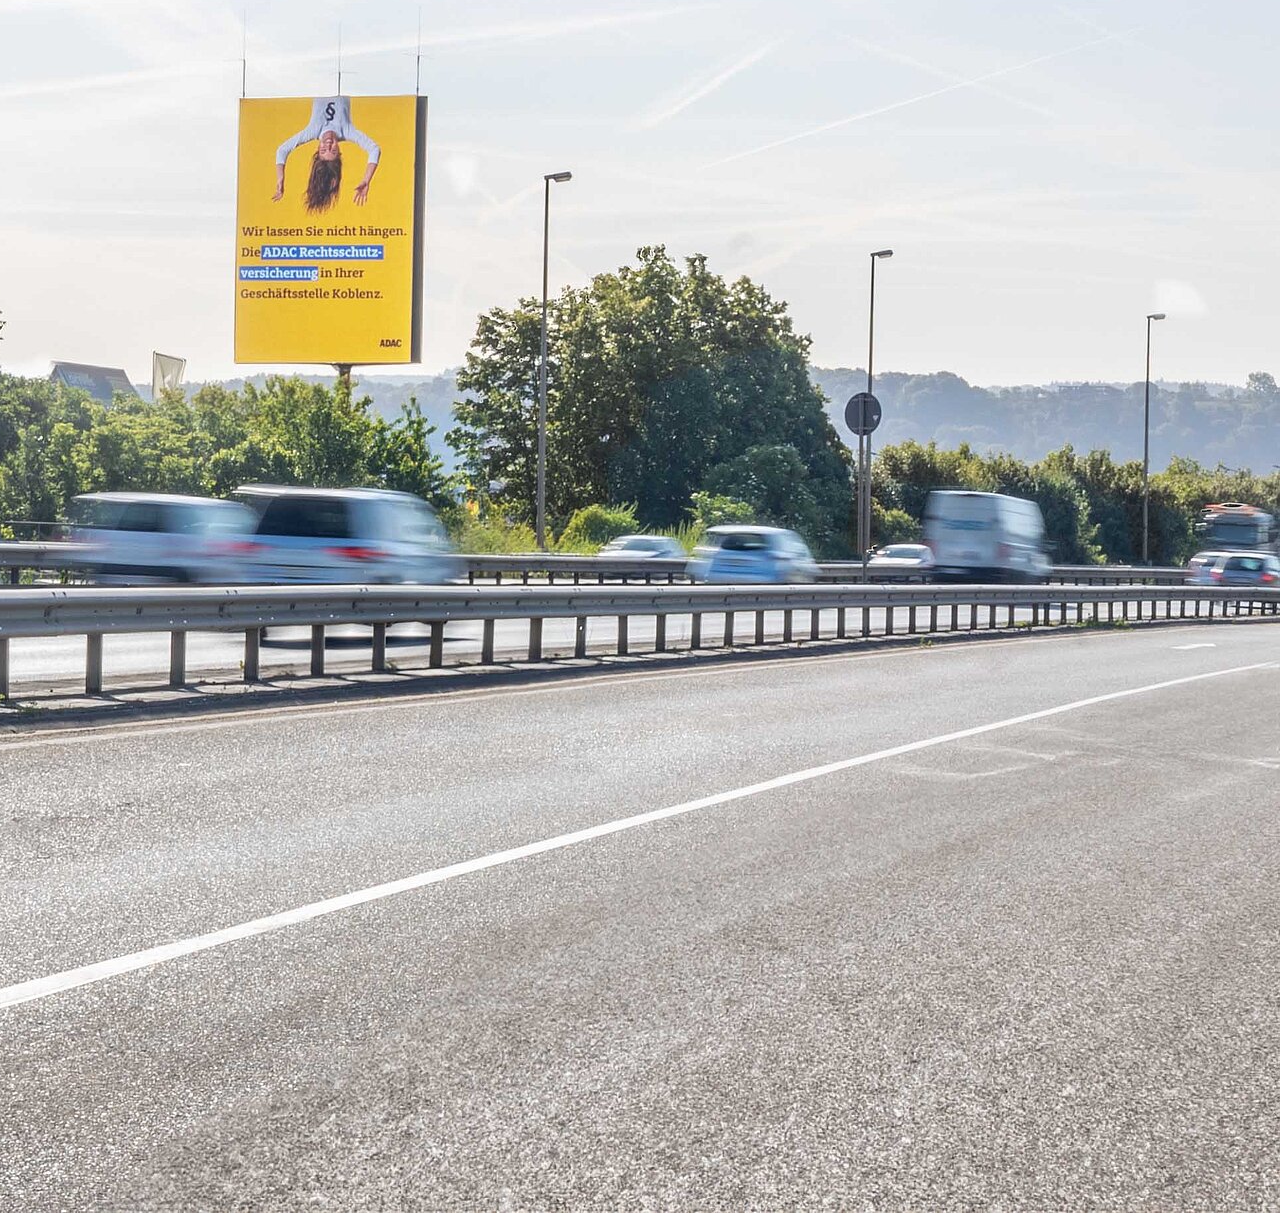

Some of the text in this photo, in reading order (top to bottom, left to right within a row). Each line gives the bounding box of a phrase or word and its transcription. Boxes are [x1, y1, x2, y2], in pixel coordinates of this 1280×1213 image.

[242, 226, 407, 239] Wir lassen Sie nicht hängen.
[241, 246, 382, 258] Die ADAC Rechtsschutz-
[240, 267, 365, 281] versicherung in Ihrer
[240, 288, 383, 299] Geschäftsstelle Koblenz.
[379, 339, 402, 348] ADAC
